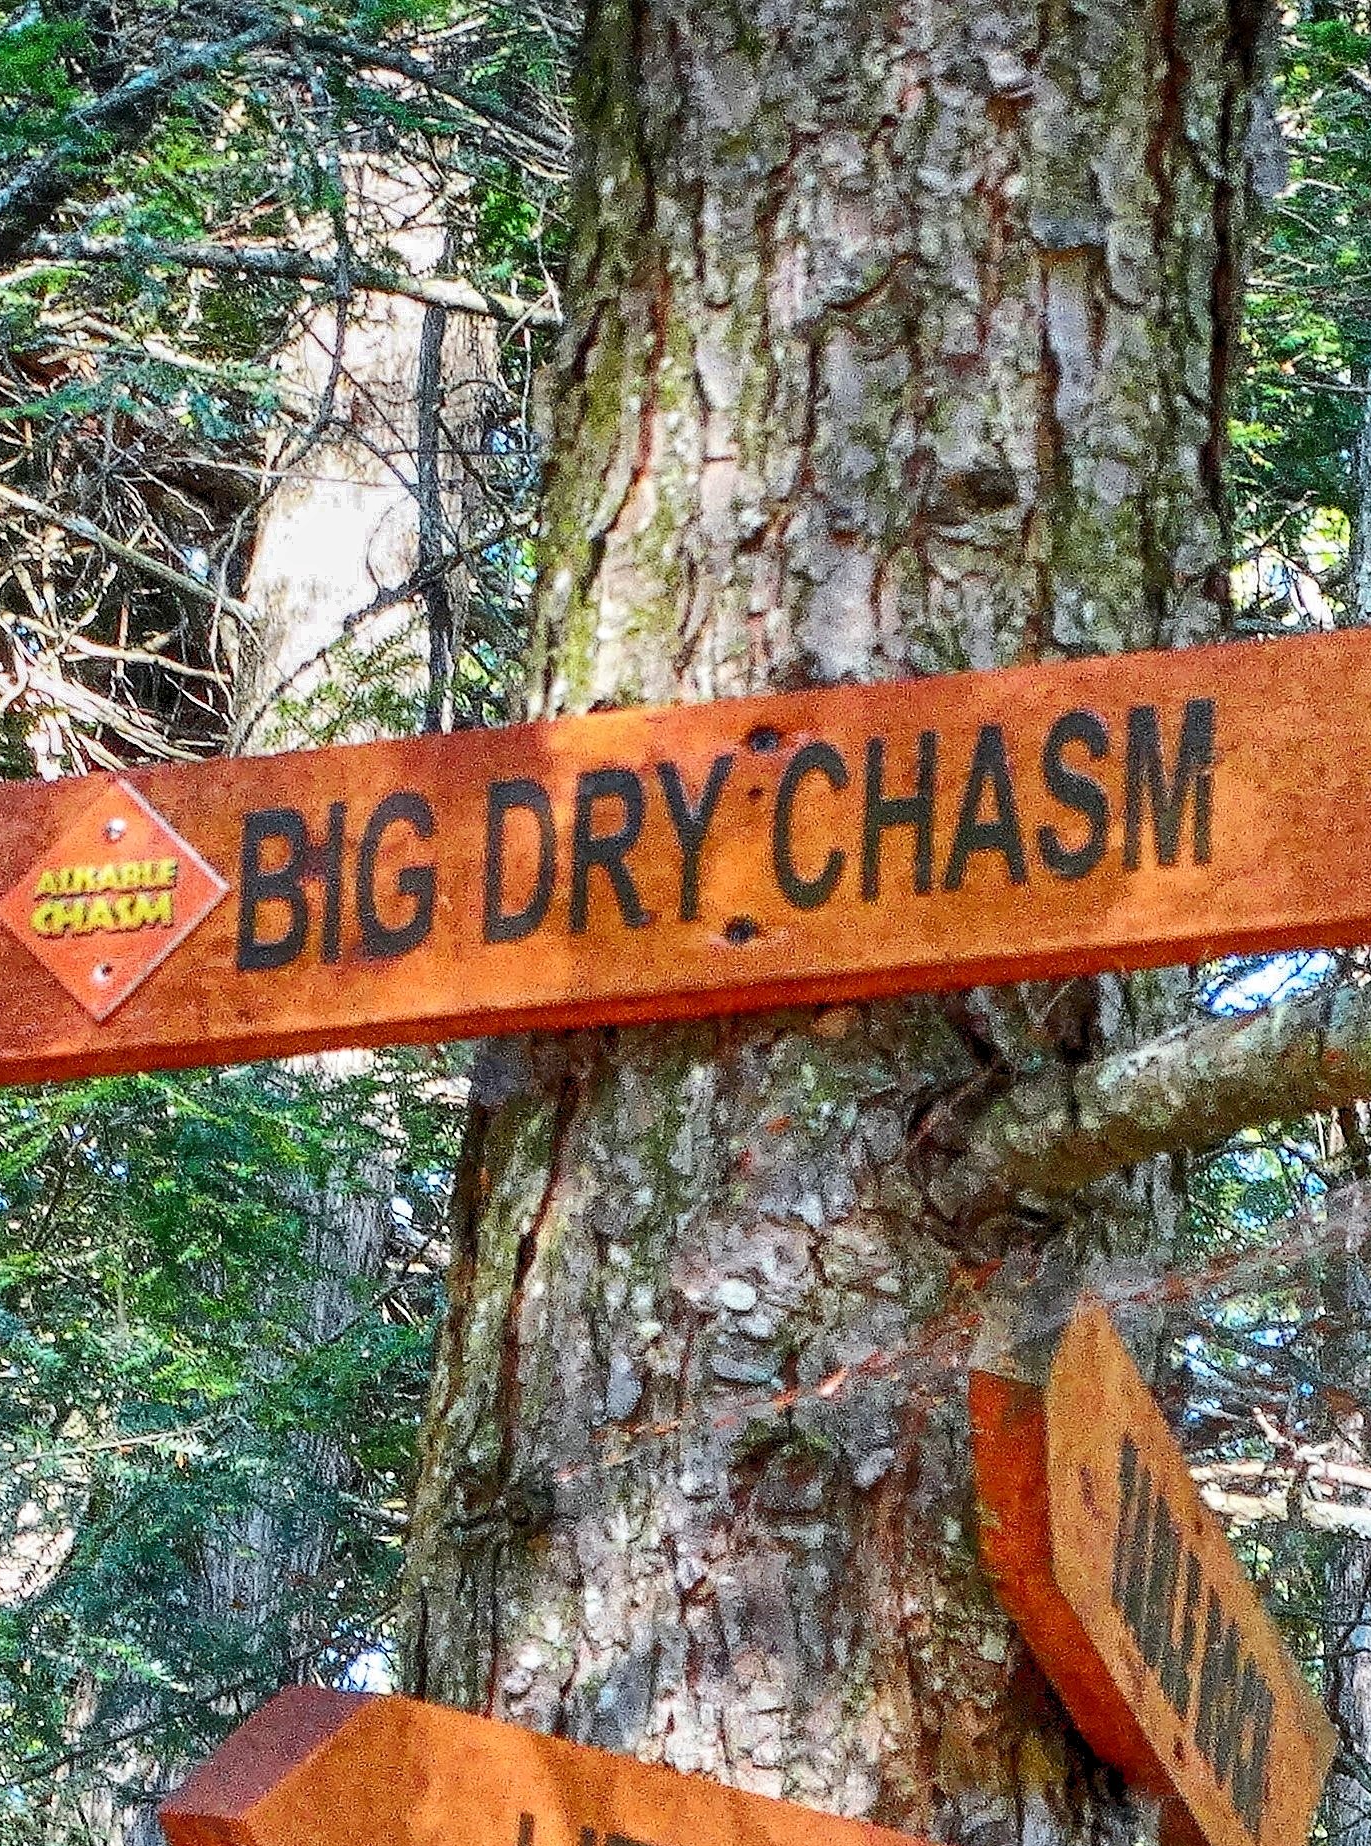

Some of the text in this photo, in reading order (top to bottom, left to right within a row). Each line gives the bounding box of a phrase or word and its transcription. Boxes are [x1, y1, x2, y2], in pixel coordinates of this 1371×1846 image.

[29, 890, 175, 937] CHASM
[235, 698, 1217, 971] BIG DRY CHASM
